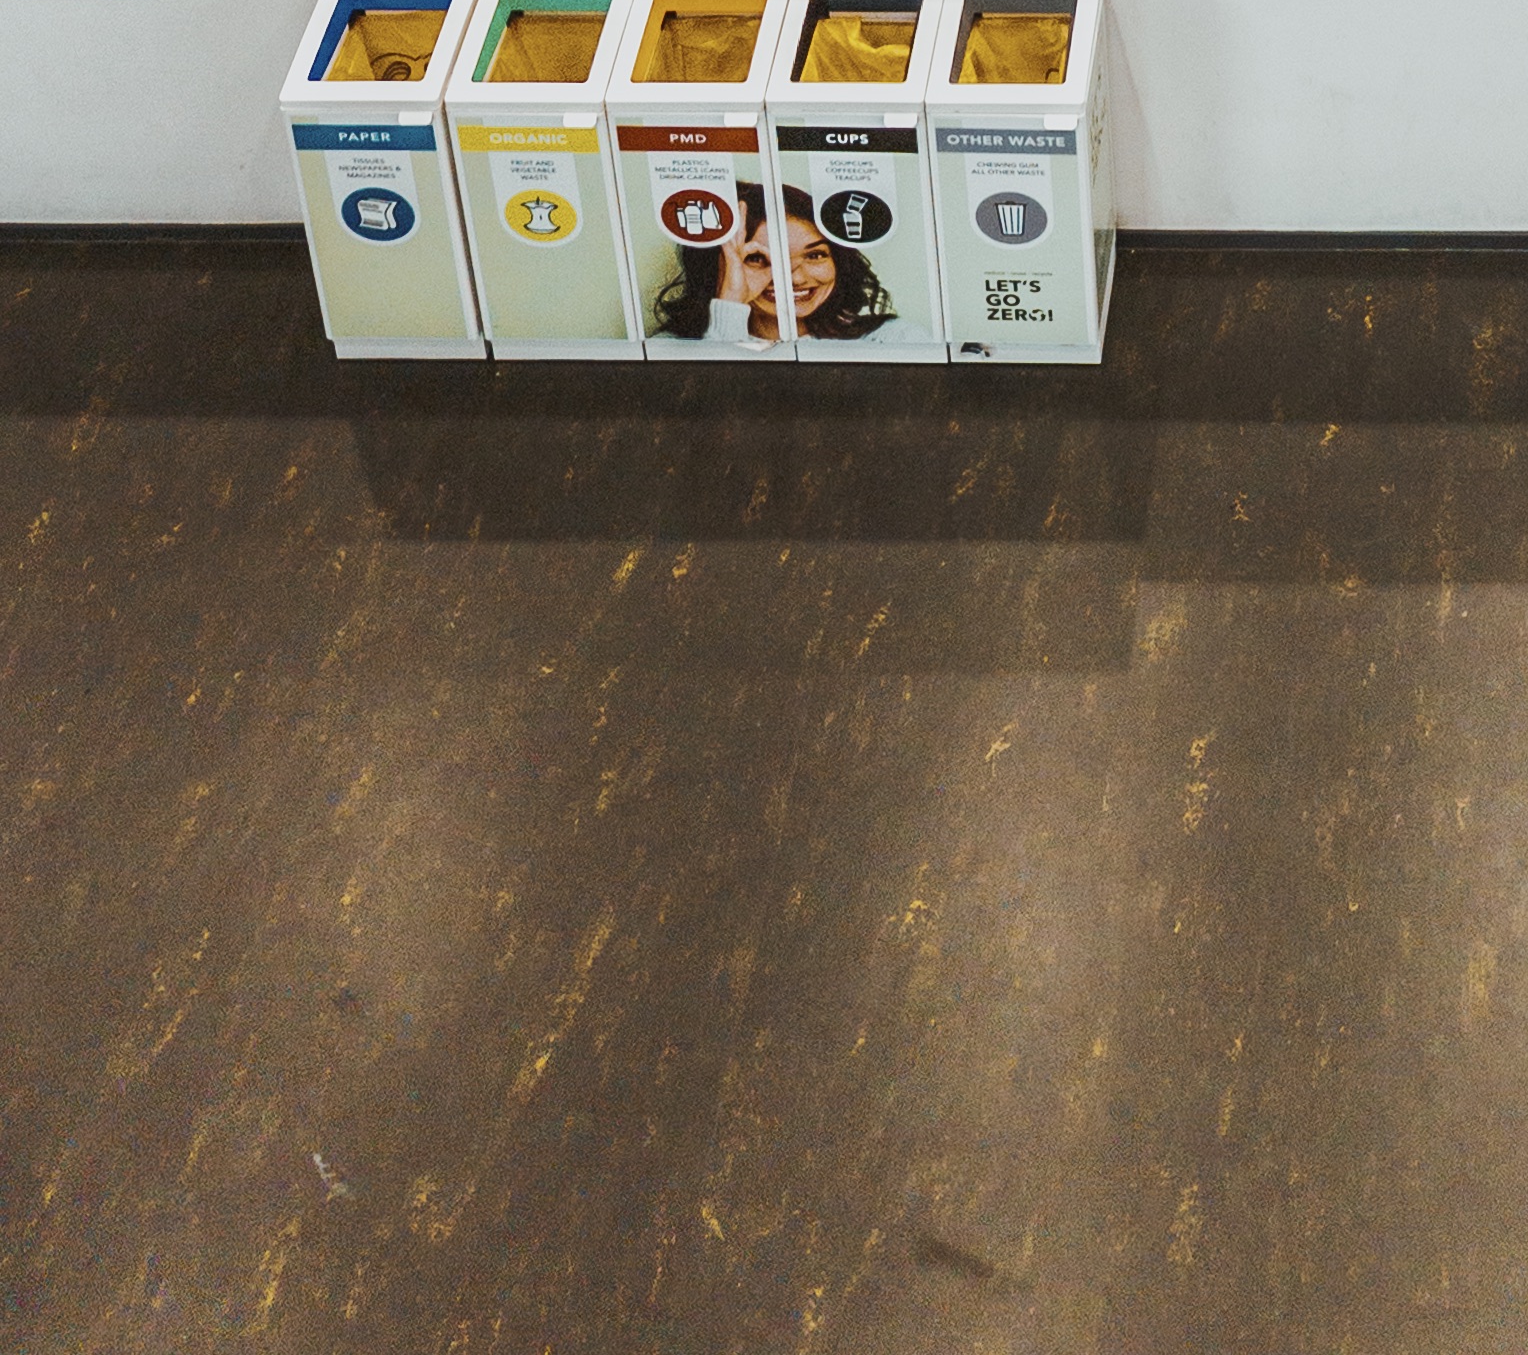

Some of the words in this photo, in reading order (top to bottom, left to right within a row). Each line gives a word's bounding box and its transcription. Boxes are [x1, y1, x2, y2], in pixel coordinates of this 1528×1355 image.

[338, 132, 391, 141] PAPER
[489, 133, 568, 144] ORGANIC
[669, 133, 707, 144] PMD
[825, 133, 869, 145] CUPS
[947, 134, 1003, 146] OTHER
[1008, 136, 1065, 147] WASTE
[985, 279, 1041, 293] LET'S
[986, 294, 1020, 306] GO
[987, 308, 1053, 322] ZERO!
